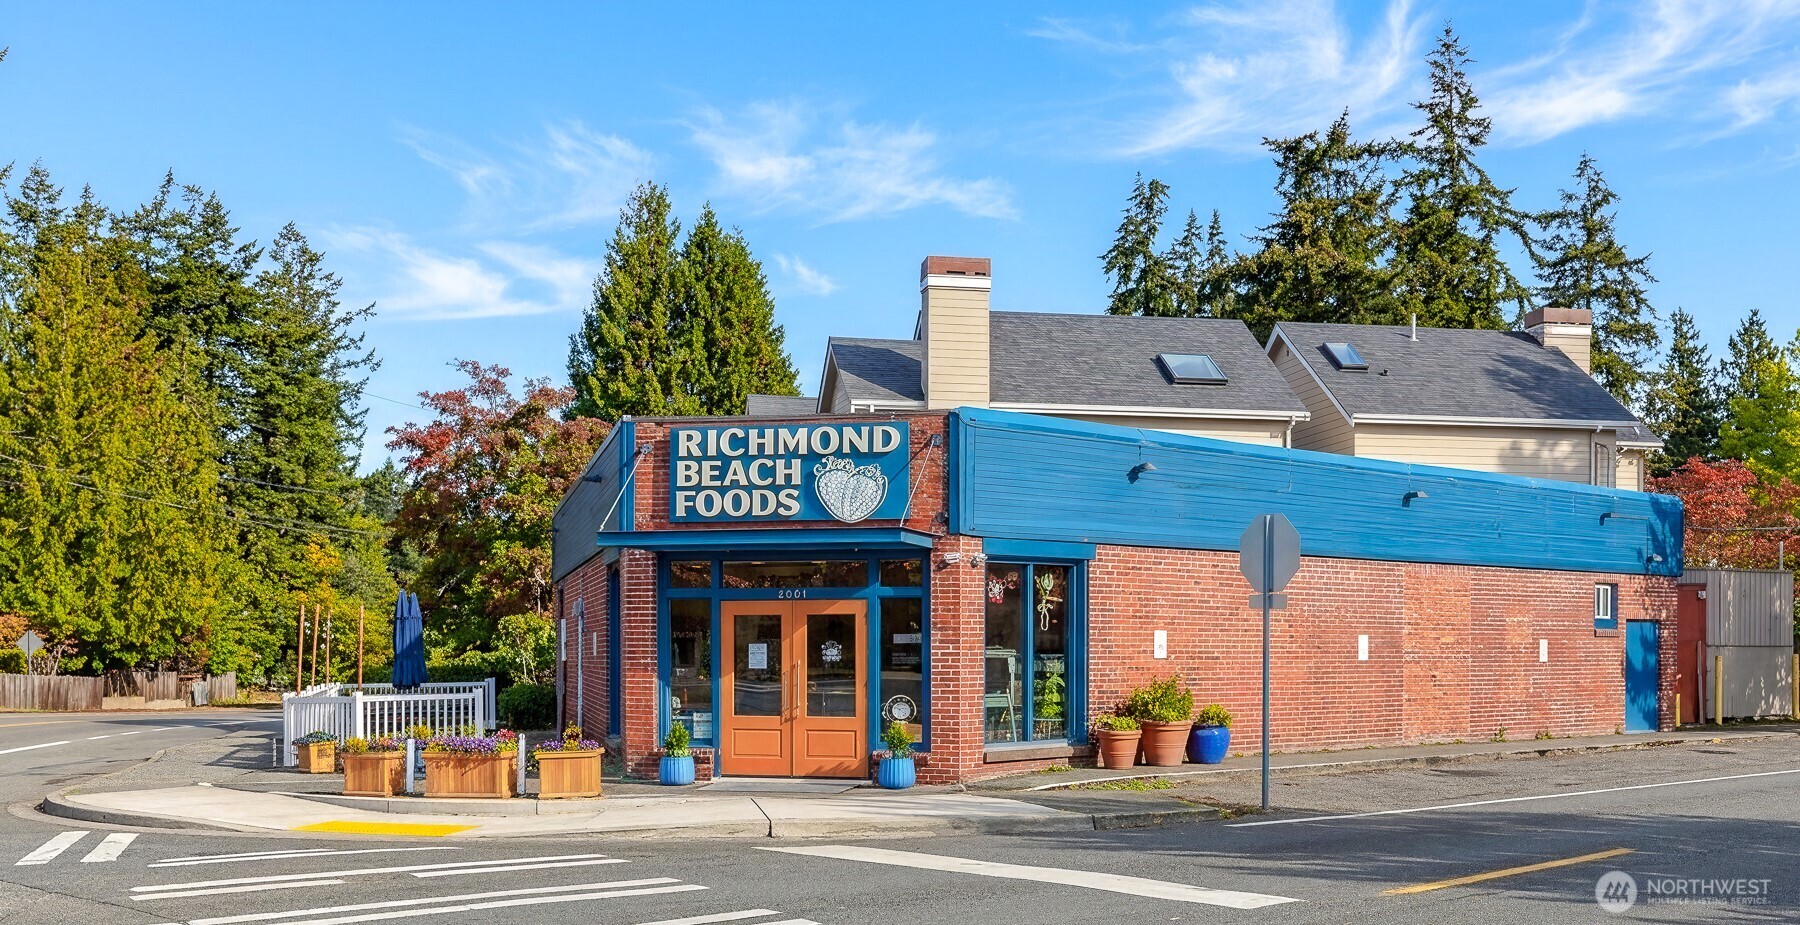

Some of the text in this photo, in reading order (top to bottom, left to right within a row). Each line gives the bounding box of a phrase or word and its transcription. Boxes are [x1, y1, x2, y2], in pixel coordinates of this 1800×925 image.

[677, 426, 901, 457] RICHMOND
[676, 458, 802, 487] BEACH
[675, 489, 801, 517] FOODS
[778, 589, 806, 599] 2001
